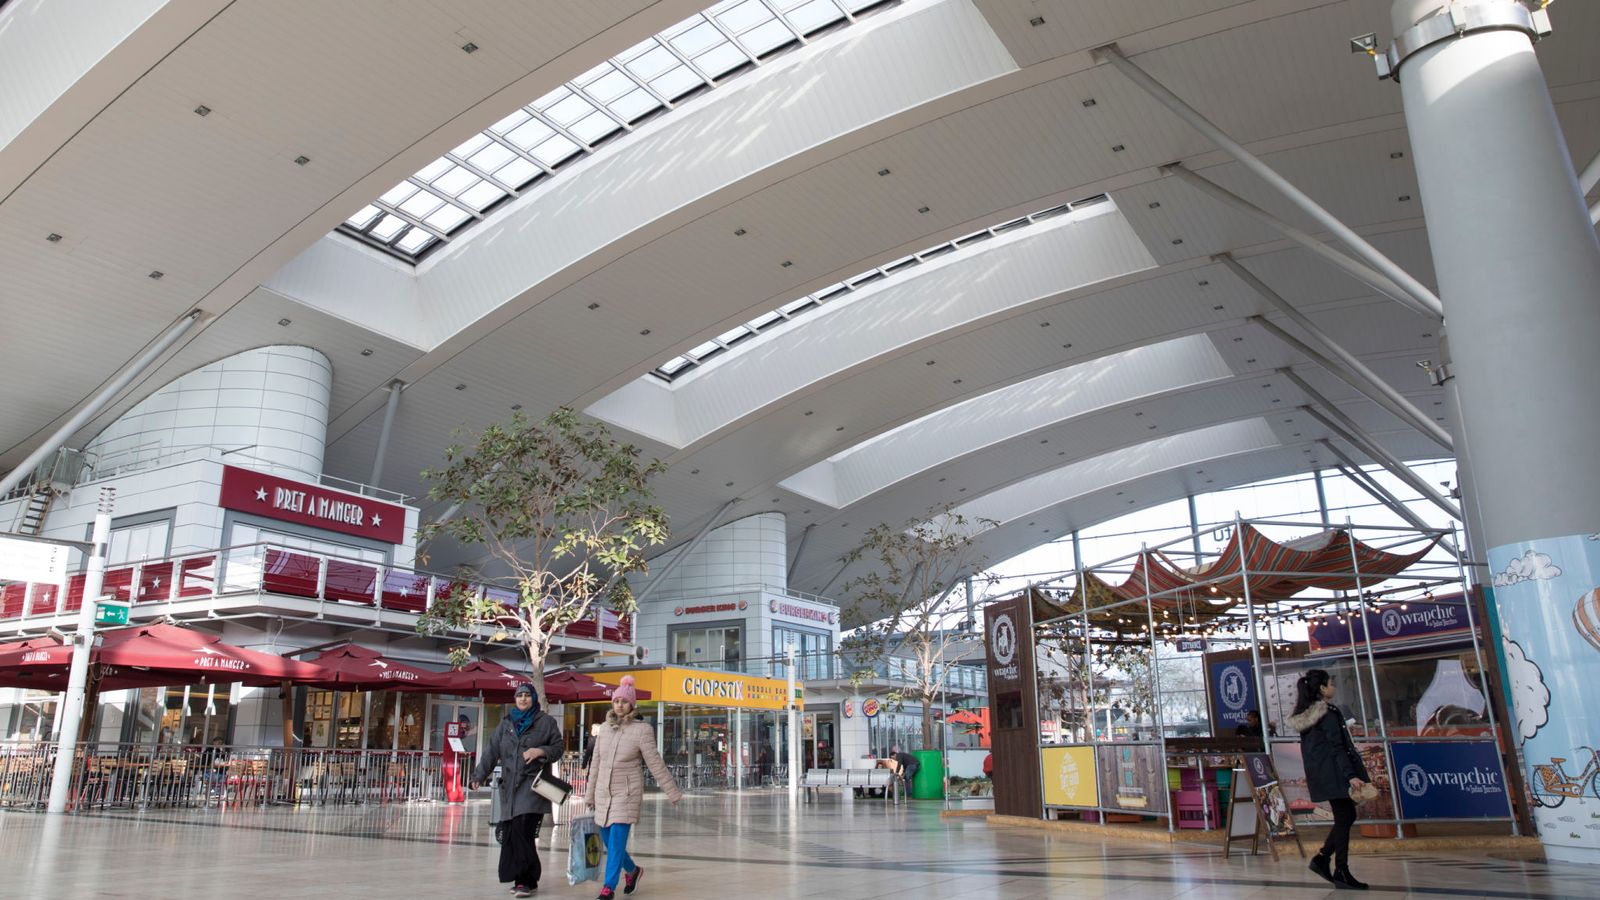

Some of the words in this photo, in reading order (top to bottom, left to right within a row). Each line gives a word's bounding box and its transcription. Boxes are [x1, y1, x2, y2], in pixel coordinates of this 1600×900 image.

[274, 487, 306, 513] PRET
[307, 495, 316, 517] A
[318, 496, 363, 527] MANGER
[685, 603, 715, 615] BURGER
[716, 602, 736, 612] KING
[1401, 604, 1456, 626] wrapchic
[200, 656, 214, 667] PRET
[214, 658, 219, 668] A
[220, 658, 245, 670] MANGER
[382, 670, 393, 679] PRET
[395, 670, 415, 680] MANGER
[683, 677, 744, 701] CHOPSTIX
[1427, 766, 1498, 790] wrapchic
